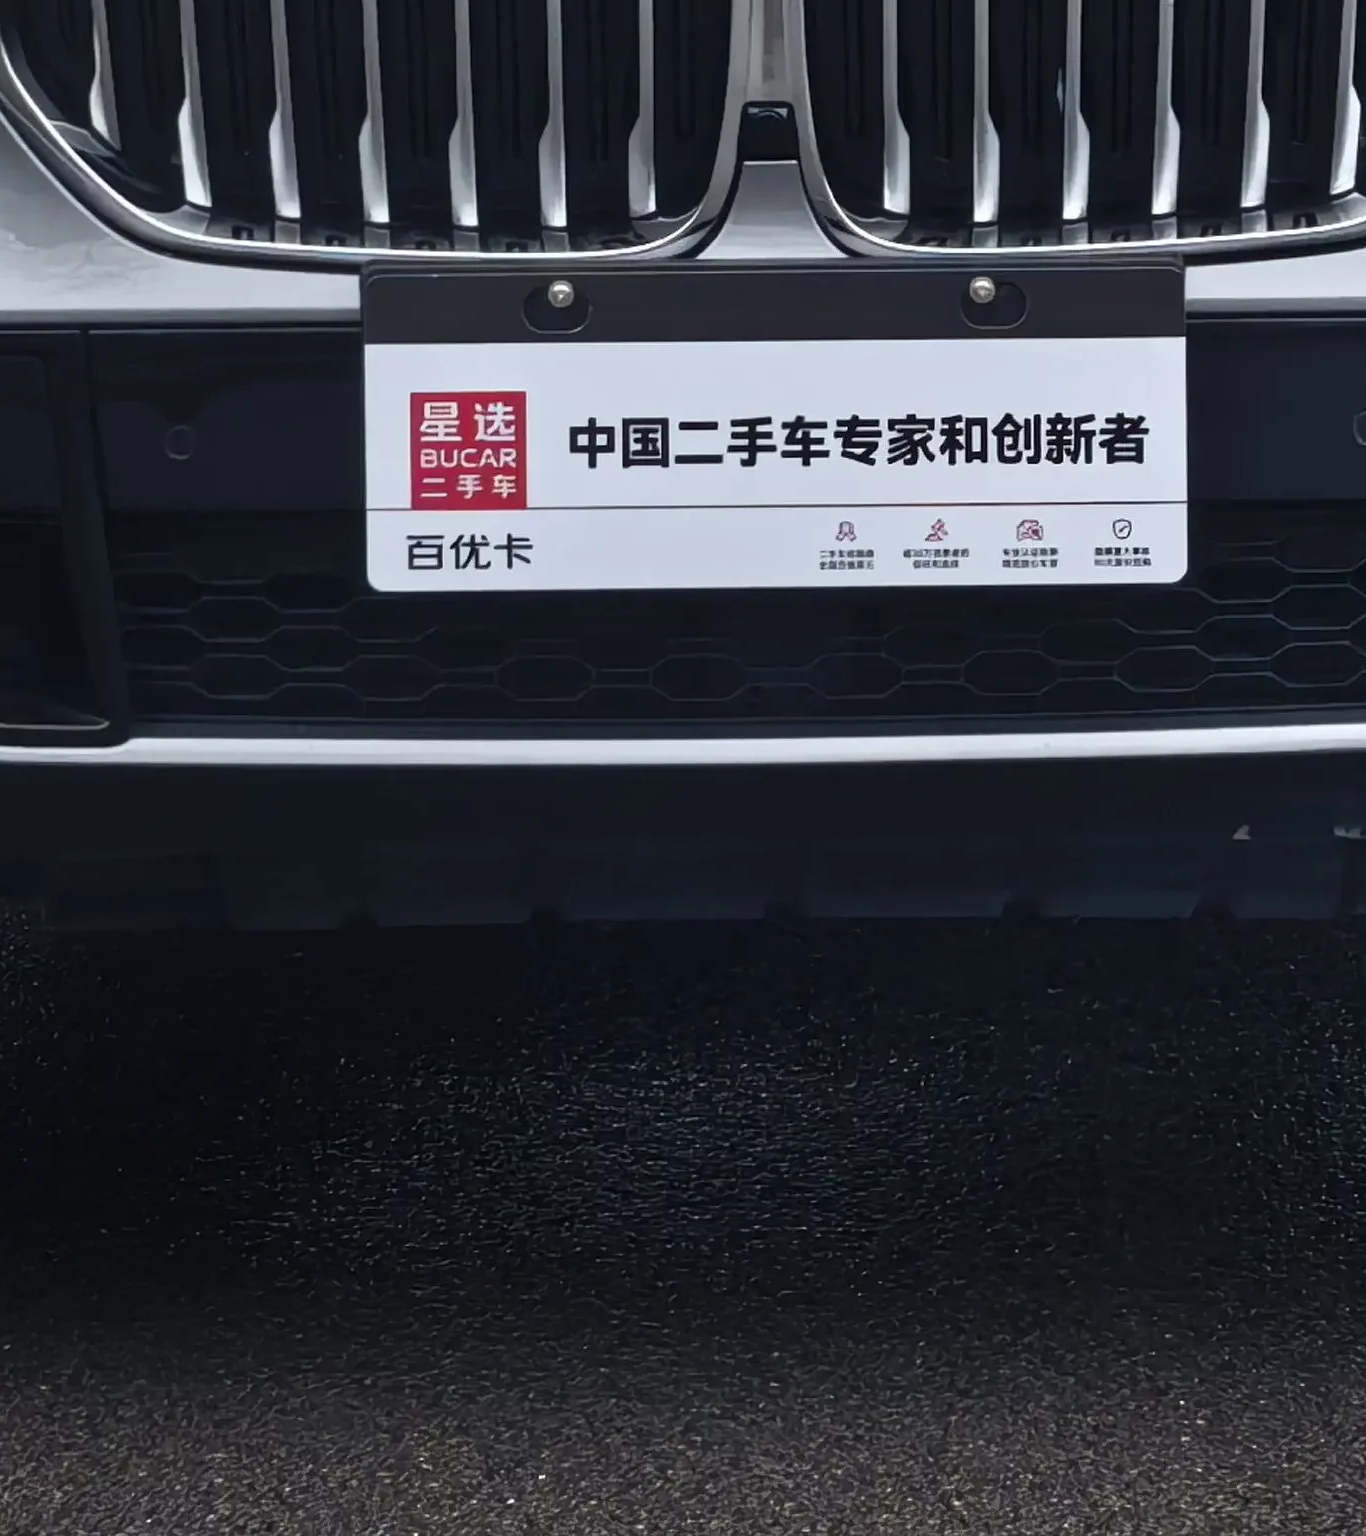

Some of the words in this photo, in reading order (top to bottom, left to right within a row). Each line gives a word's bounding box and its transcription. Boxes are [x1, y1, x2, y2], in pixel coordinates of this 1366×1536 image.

[419, 401, 515, 442] 星选
[569, 412, 1150, 468] 中国二手车专家和创新者
[420, 448, 517, 469] BUCAR
[420, 474, 517, 499] 二手车
[406, 533, 533, 570] 百优卡
